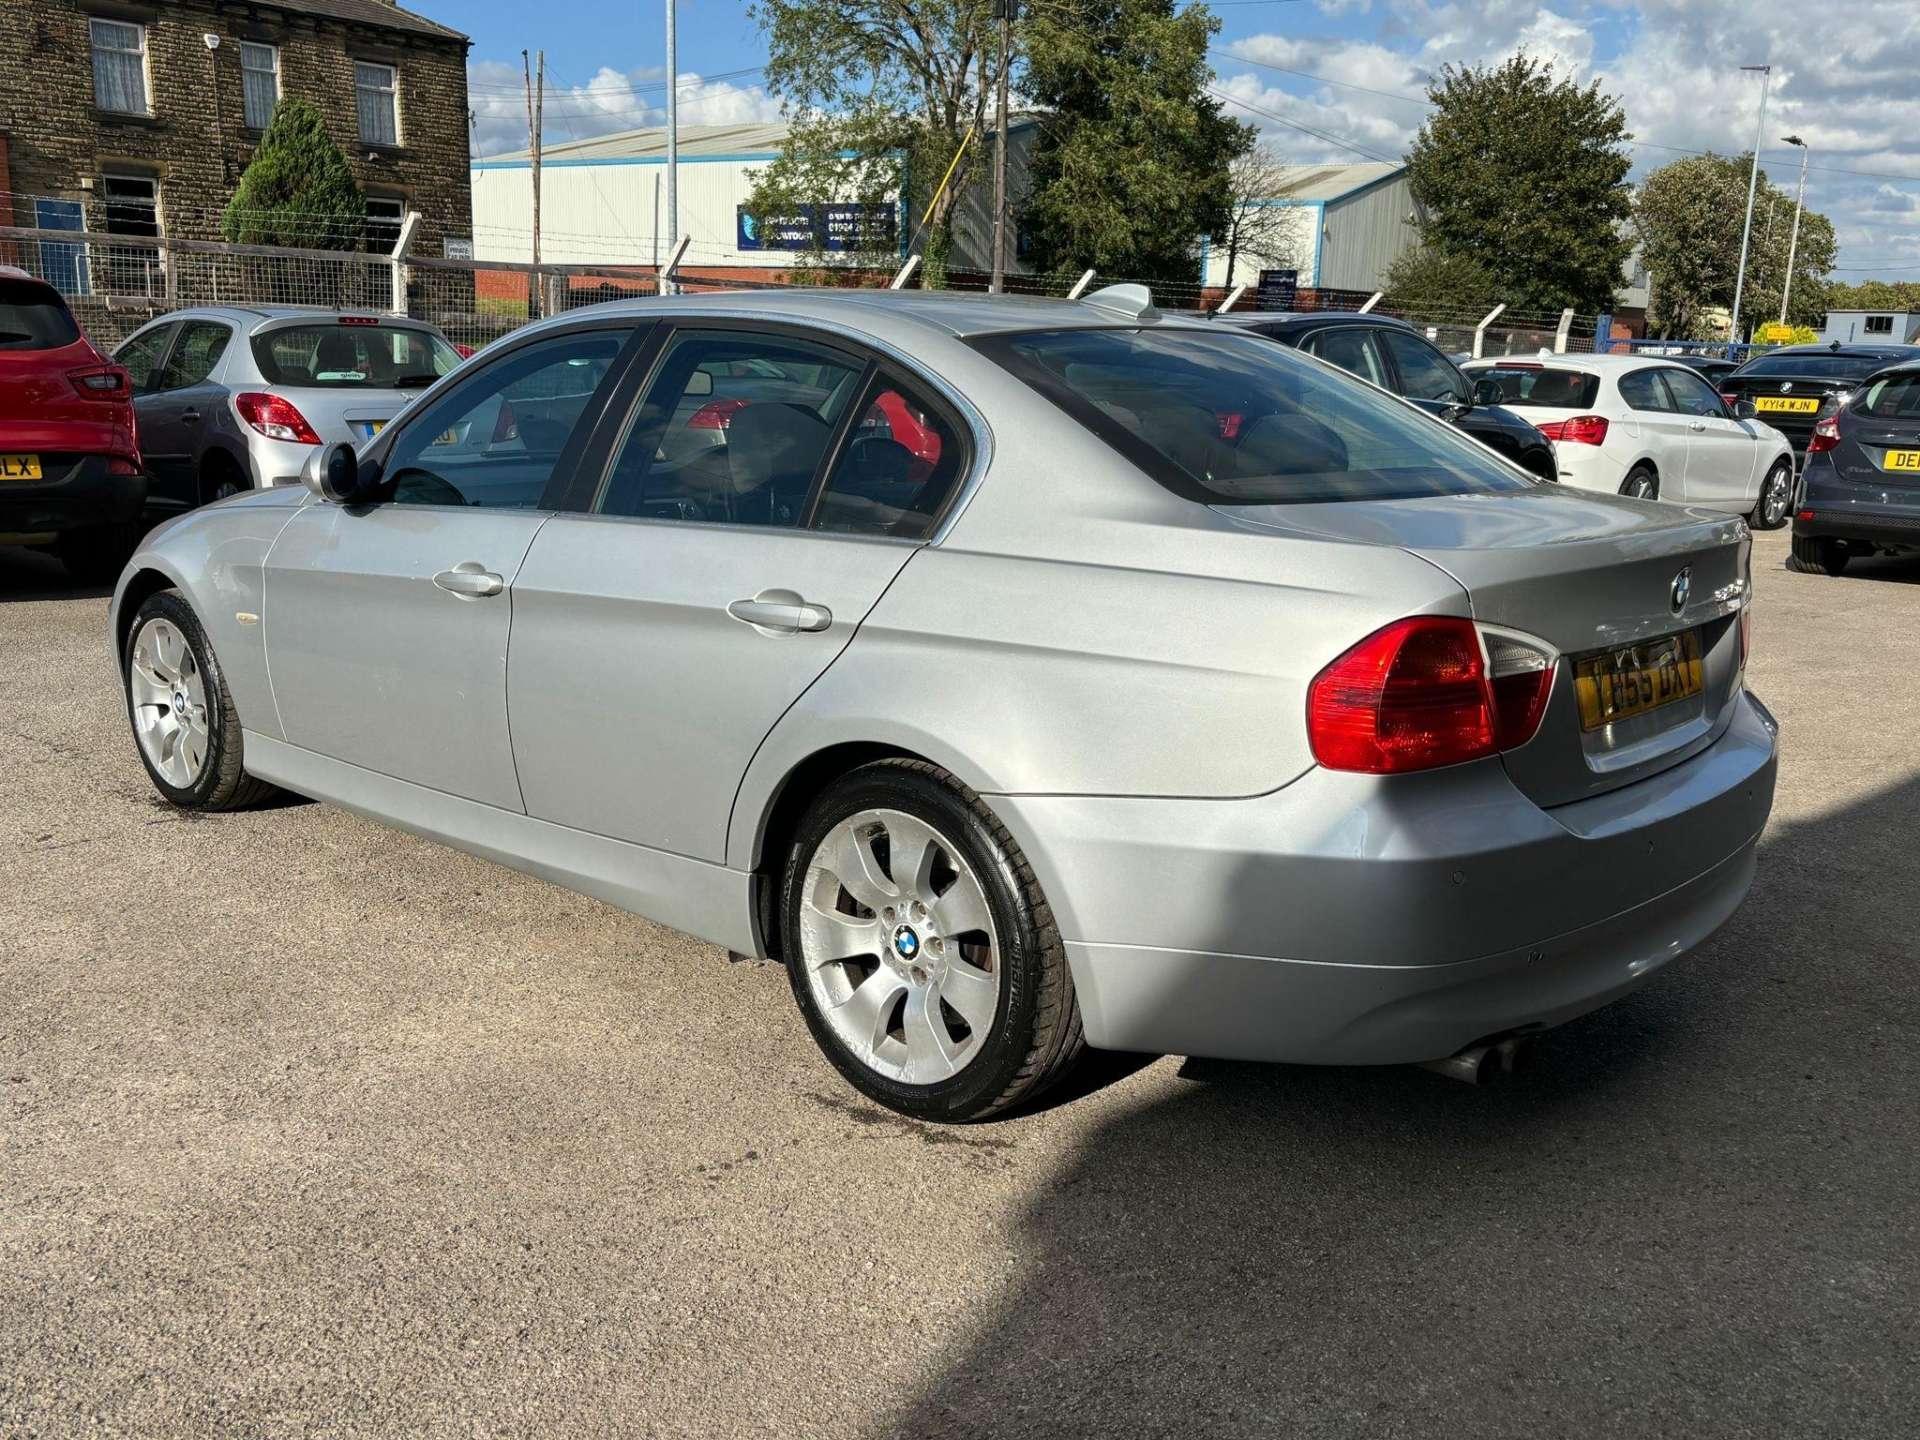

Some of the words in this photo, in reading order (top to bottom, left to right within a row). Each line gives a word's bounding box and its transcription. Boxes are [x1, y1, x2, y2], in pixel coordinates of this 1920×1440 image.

[1763, 399, 1786, 409] YY14
[1789, 400, 1811, 410] WJN
[0, 457, 32, 476] LX
[1895, 453, 1920, 468] DE
